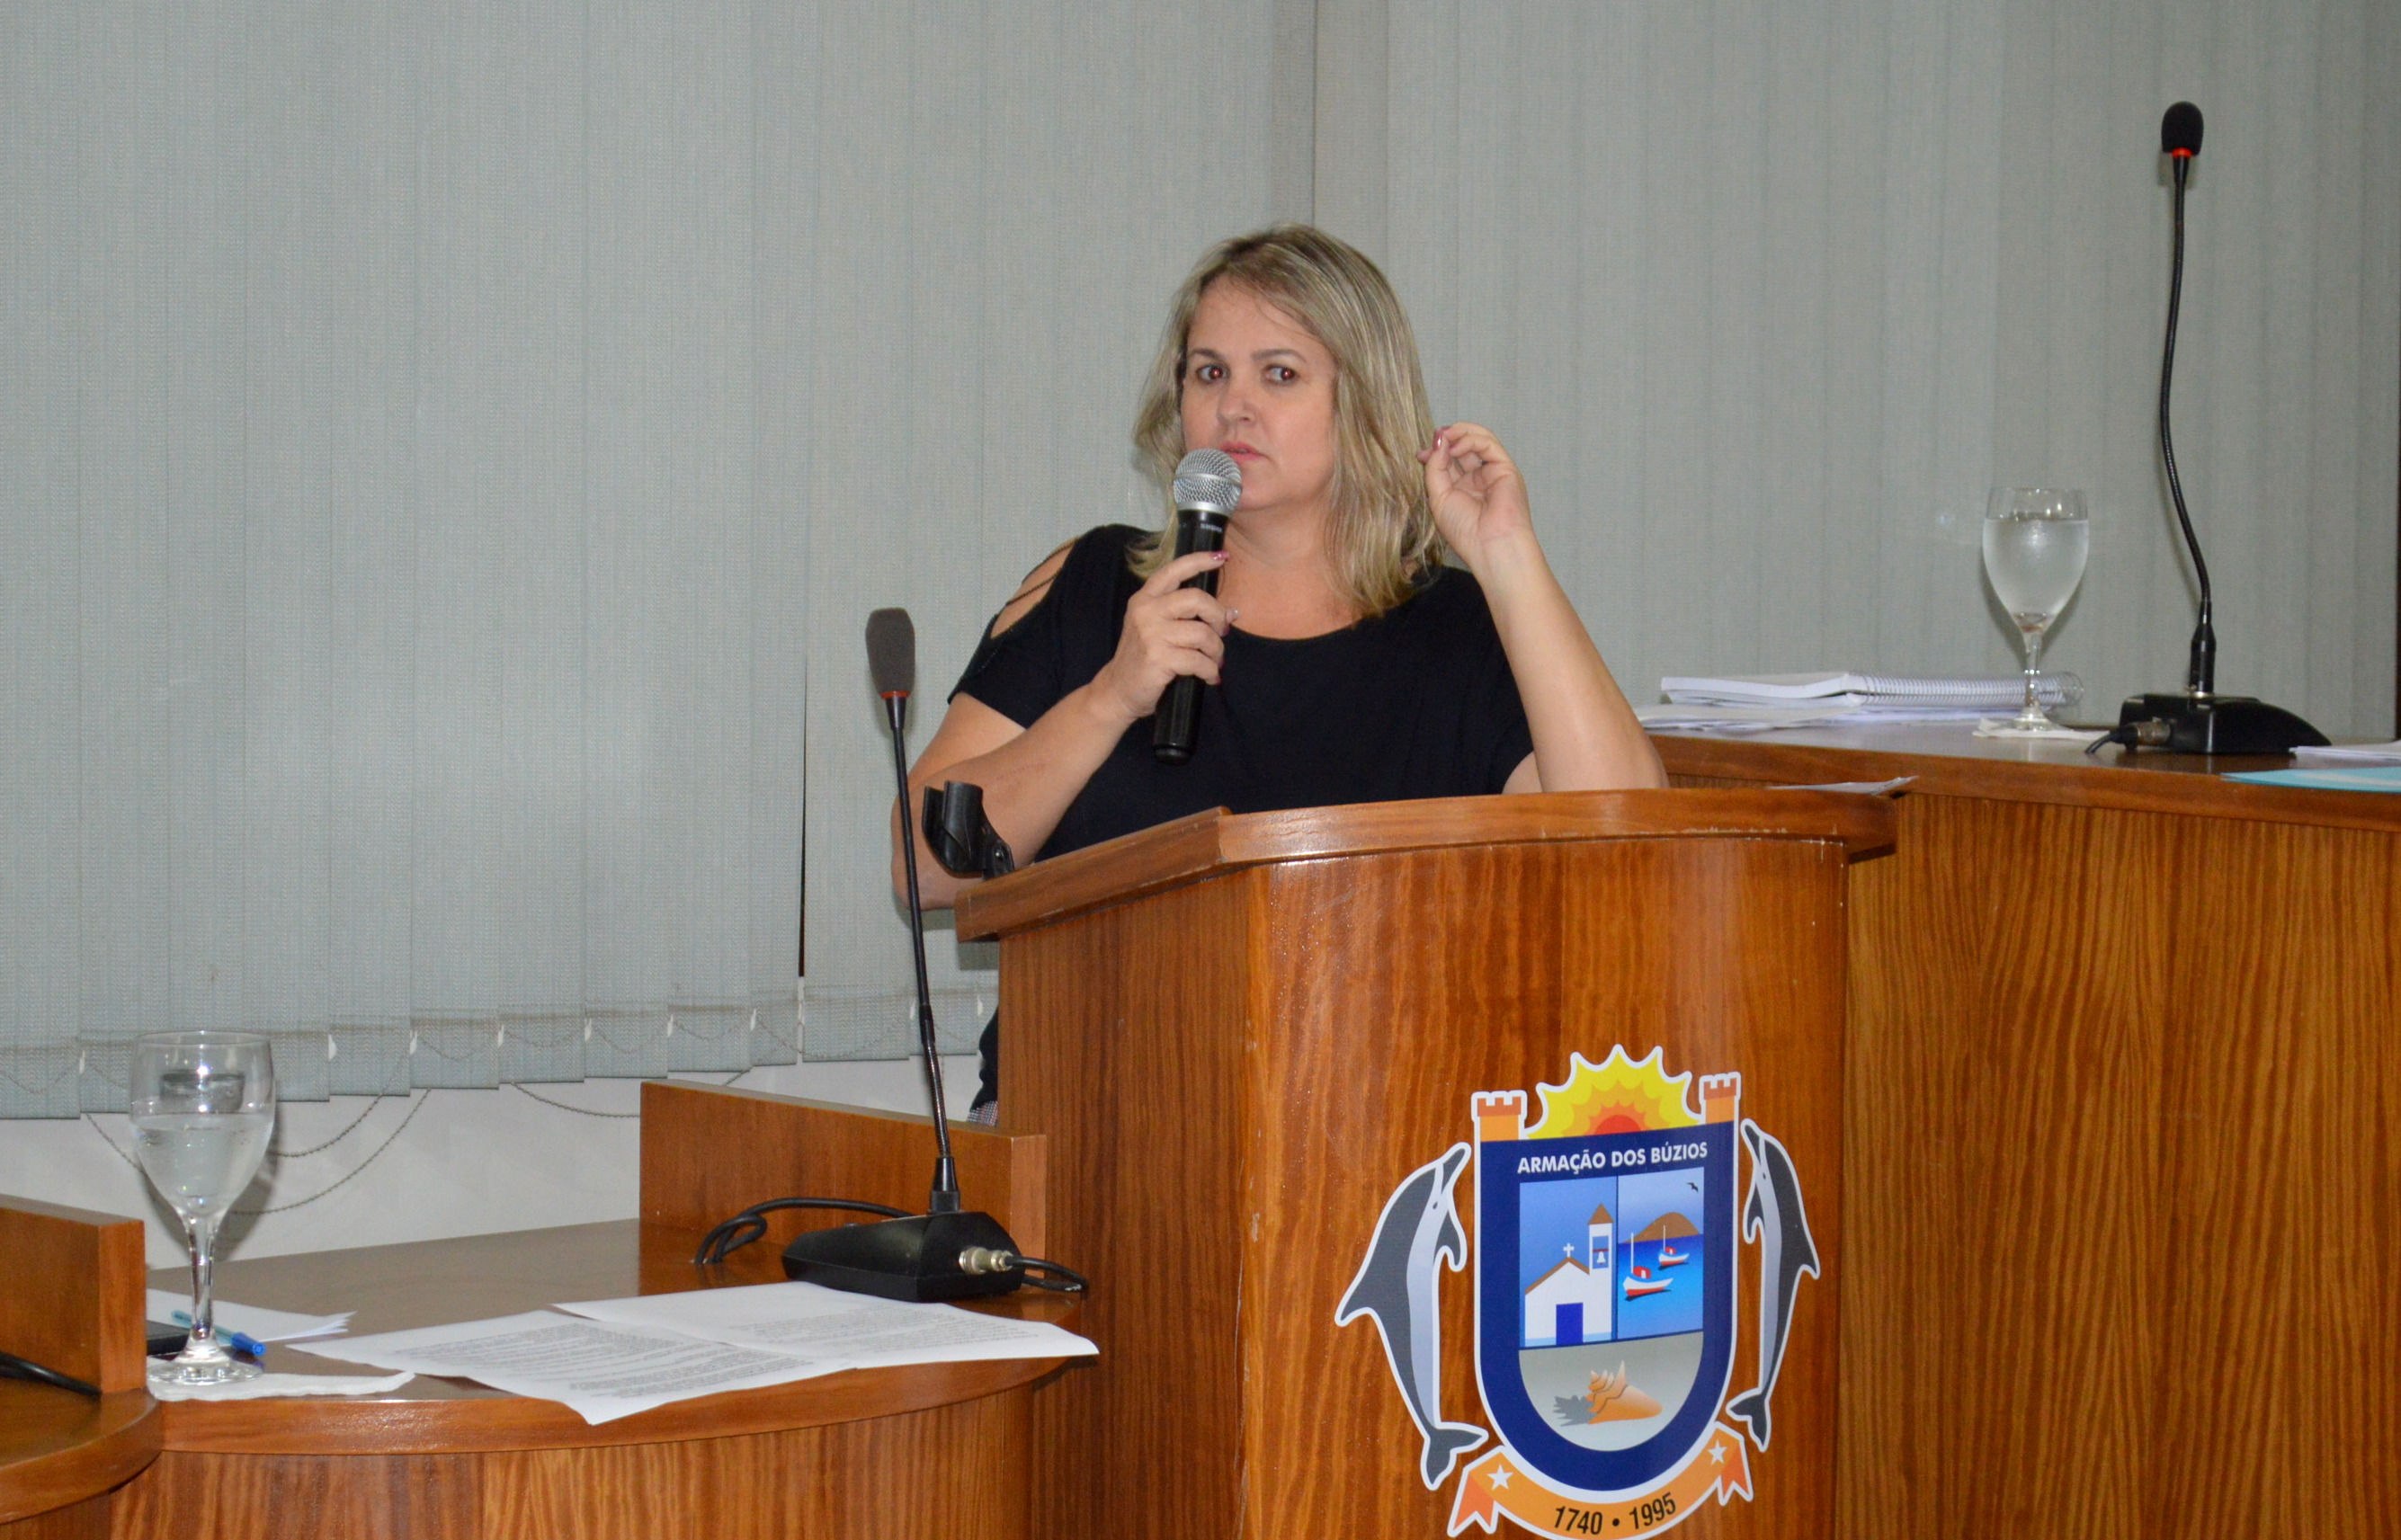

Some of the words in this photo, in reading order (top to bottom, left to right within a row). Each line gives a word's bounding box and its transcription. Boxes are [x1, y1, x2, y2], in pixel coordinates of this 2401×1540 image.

[1517, 1148, 1606, 1174] ARMAÇÃO
[1611, 1148, 1646, 1167] DOS
[1651, 1141, 1708, 1163] BÚZIOS
[1554, 1505, 1603, 1536] 1740
[1629, 1491, 1676, 1530] 1995
